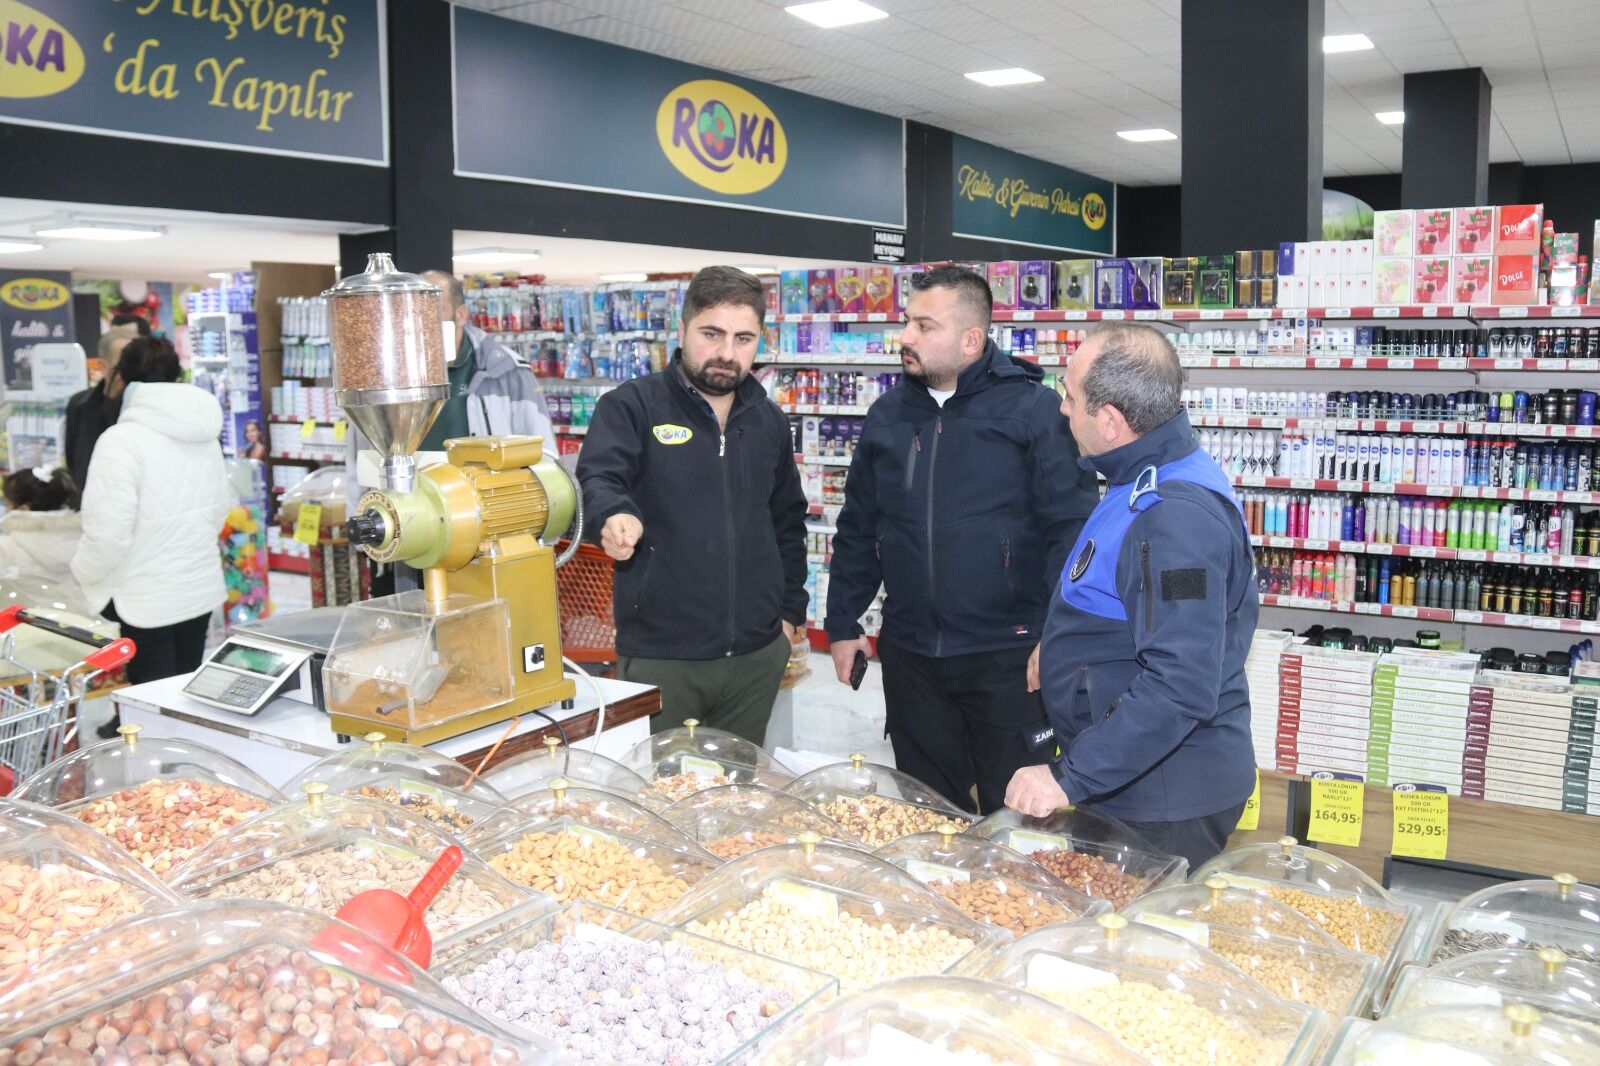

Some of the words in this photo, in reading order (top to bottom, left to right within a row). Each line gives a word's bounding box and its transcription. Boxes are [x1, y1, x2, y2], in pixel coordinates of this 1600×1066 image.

[0, 21, 66, 73] KA
[195, 57, 353, 131] Yapılır
[672, 97, 776, 171] ROKA
[958, 165, 995, 201] Kalite
[875, 231, 903, 245] MANAV
